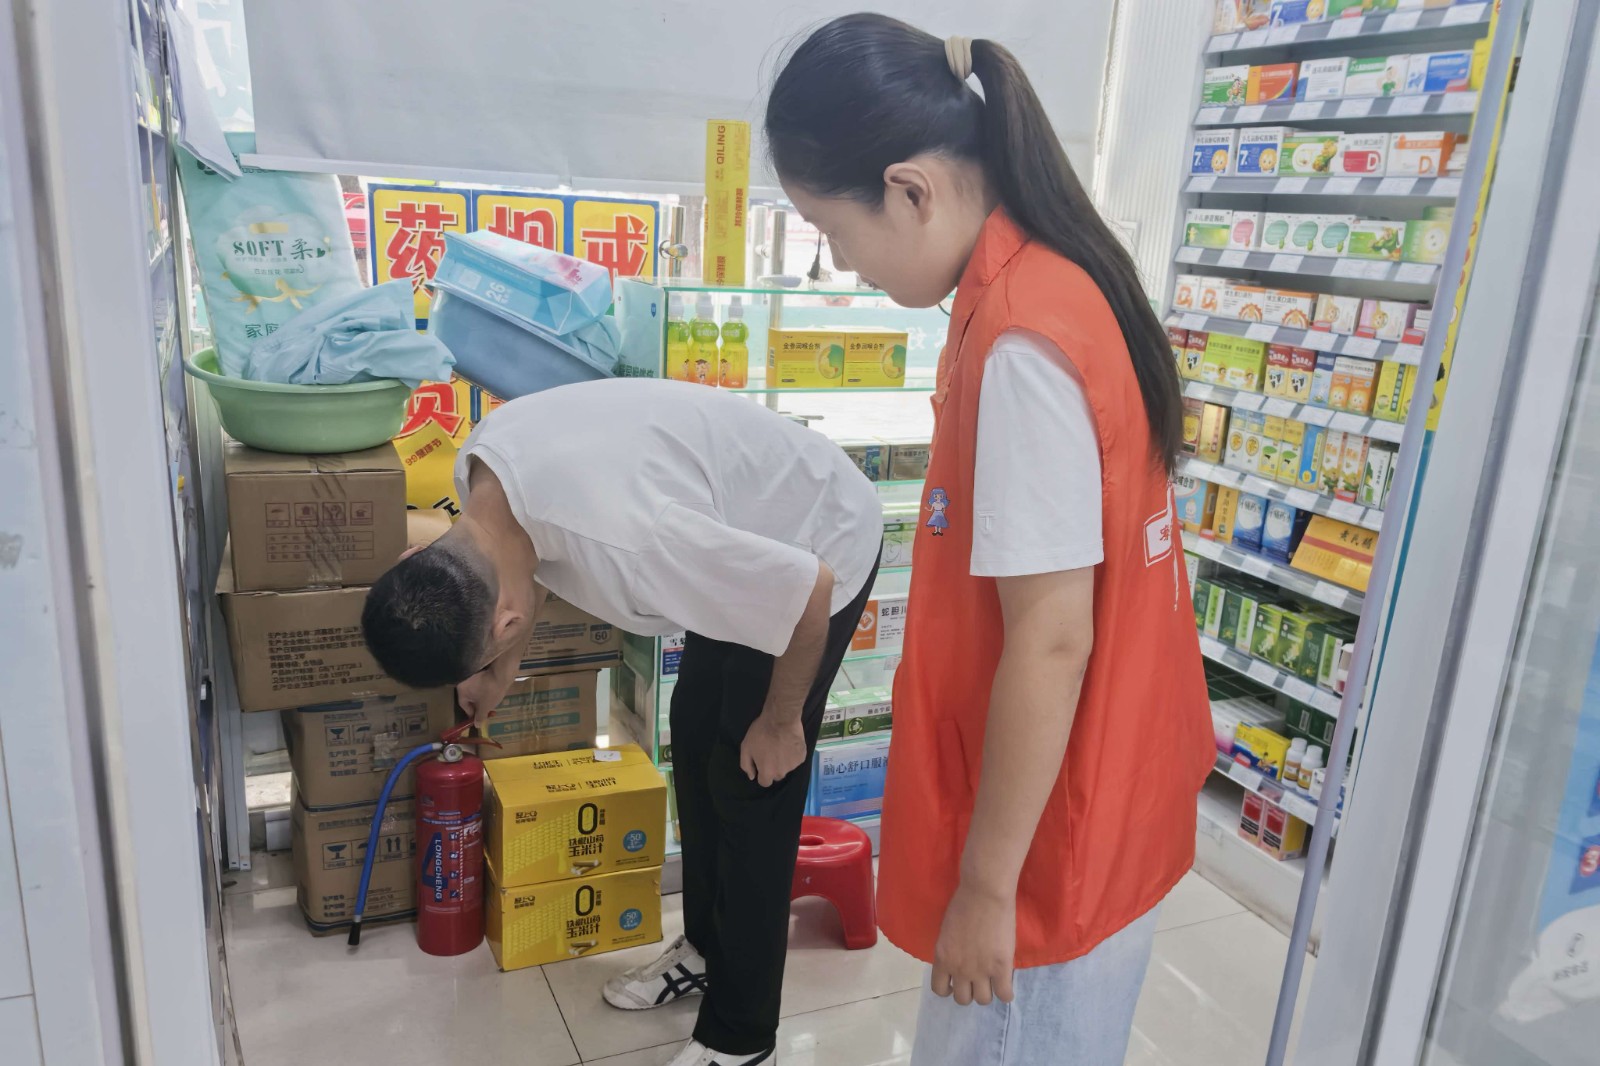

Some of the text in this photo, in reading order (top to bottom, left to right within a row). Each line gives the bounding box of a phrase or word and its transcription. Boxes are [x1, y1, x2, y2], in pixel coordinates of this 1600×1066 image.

[716, 125, 726, 165] QILING
[1366, 153, 1379, 171] D
[1418, 155, 1433, 175] D
[232, 238, 314, 260] SOFT 柔
[485, 281, 506, 303] 26
[594, 631, 608, 641] 60
[568, 842, 604, 858] 玉米汁
[434, 839, 443, 900] LONGCHENG
[566, 925, 601, 939] 玉米汁
